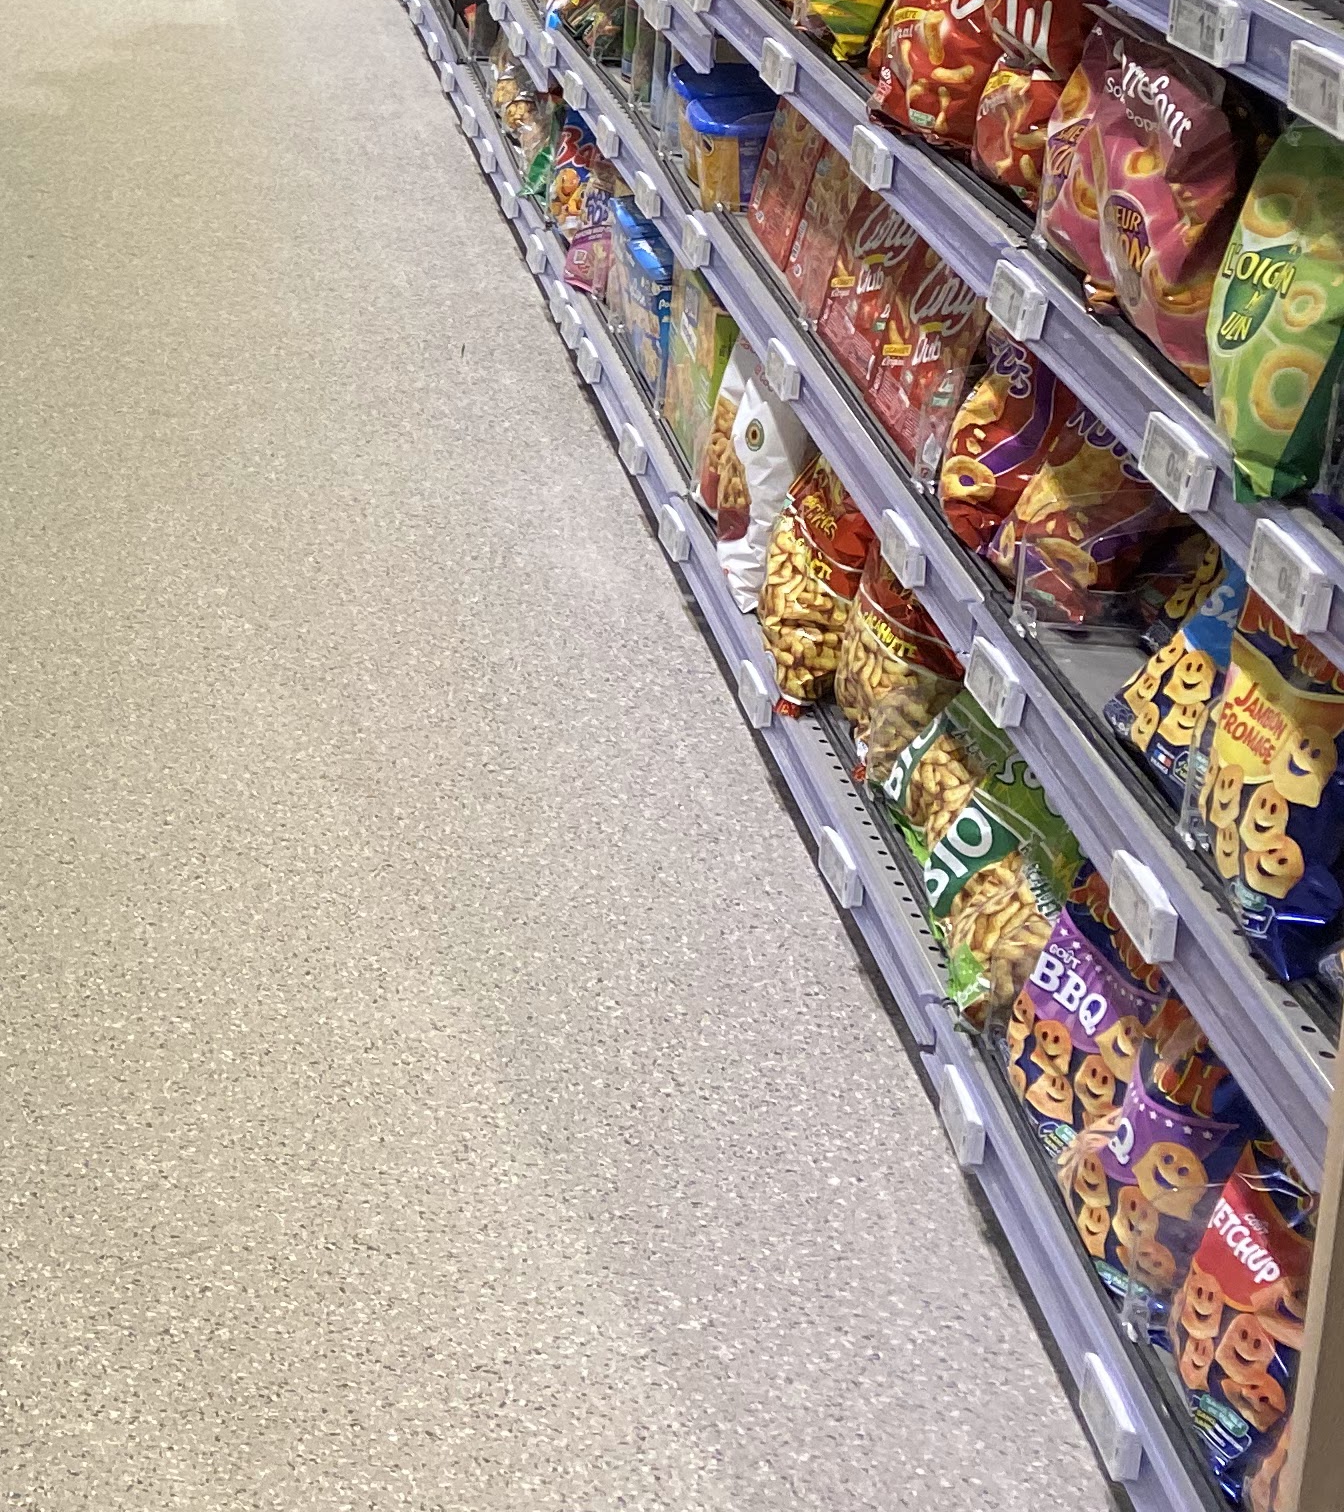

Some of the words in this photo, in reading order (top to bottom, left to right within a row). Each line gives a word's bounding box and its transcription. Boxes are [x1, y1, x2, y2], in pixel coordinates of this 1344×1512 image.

[1220, 704, 1277, 766] FROMAGE
[1233, 682, 1288, 745] JAMBON
[924, 805, 994, 909] BIO
[1049, 942, 1082, 970] GOÛT
[1030, 951, 1108, 1036] BBQ
